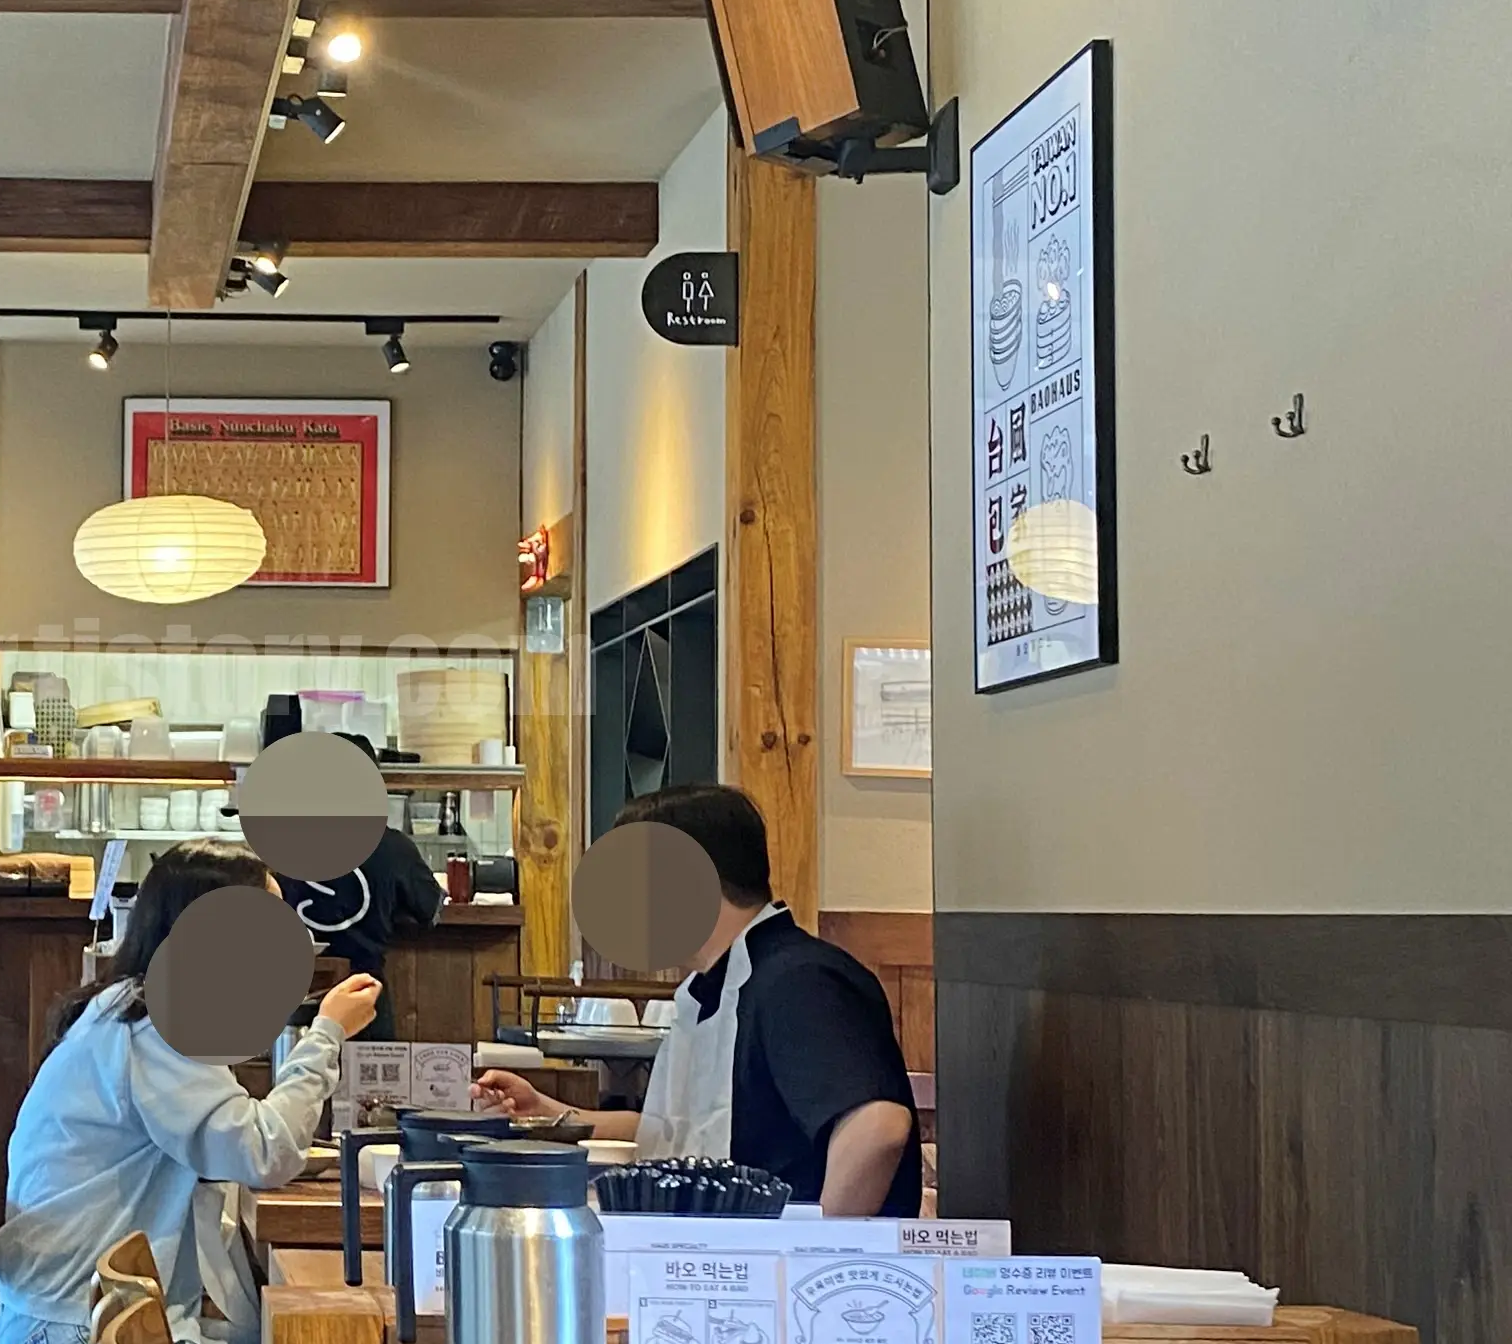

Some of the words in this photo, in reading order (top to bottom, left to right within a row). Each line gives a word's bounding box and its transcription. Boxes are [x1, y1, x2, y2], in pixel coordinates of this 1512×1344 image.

[1031, 117, 1076, 174] TAIWAN
[1031, 151, 1076, 229] NO.1
[666, 311, 727, 327] Restroom
[1030, 370, 1081, 414] BAOHAUS
[170, 419, 211, 434] Basic
[219, 419, 294, 436] Nunchaku
[303, 421, 339, 437] Kata
[902, 1227, 931, 1245] 바오
[935, 1227, 979, 1246] 먹는법
[666, 1261, 697, 1278] 바오
[702, 1261, 748, 1280] 먹는법
[1035, 1267, 1057, 1279] 리뷰
[1060, 1267, 1094, 1279] 이벤트
[848, 1269, 879, 1282] 맛있게
[883, 1273, 924, 1299] 드시는법
[963, 1284, 1003, 1298] Google
[1006, 1284, 1048, 1296] Review
[1051, 1285, 1086, 1296] Event
